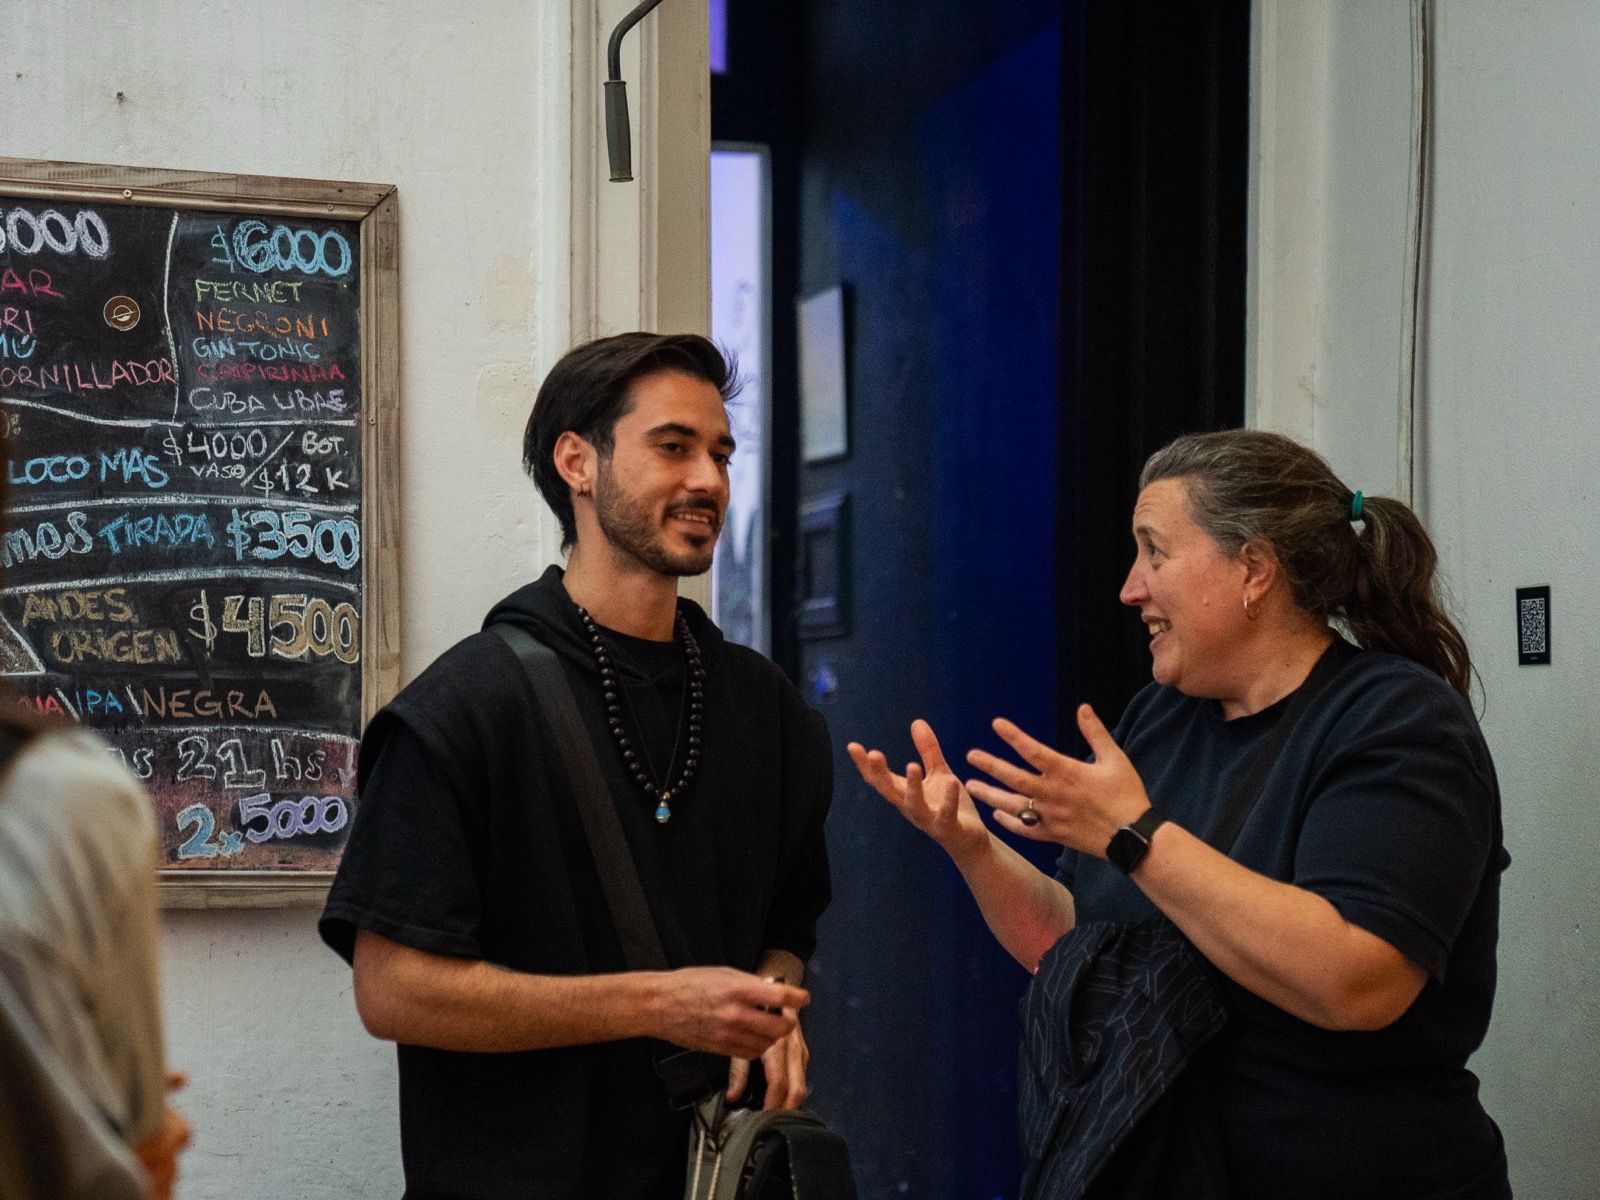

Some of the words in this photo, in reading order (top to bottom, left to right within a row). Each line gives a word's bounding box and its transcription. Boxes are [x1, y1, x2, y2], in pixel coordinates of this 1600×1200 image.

[0, 207, 109, 258] 000
[210, 219, 352, 276] $6000
[0, 307, 33, 333] RI
[195, 307, 329, 339] NEGRONI
[192, 336, 236, 359] GIN
[238, 337, 320, 361] TONIC
[0, 357, 177, 393] ORNILLADOR
[188, 386, 266, 414] CUBA
[163, 429, 267, 465] $4000
[8, 455, 90, 485] LOCO
[96, 512, 215, 555] TIRADA
[226, 508, 359, 569] $3500
[188, 589, 359, 663] $4500
[142, 686, 278, 719] NEGRA
[177, 735, 266, 789] 21
[238, 792, 348, 843] 5000
